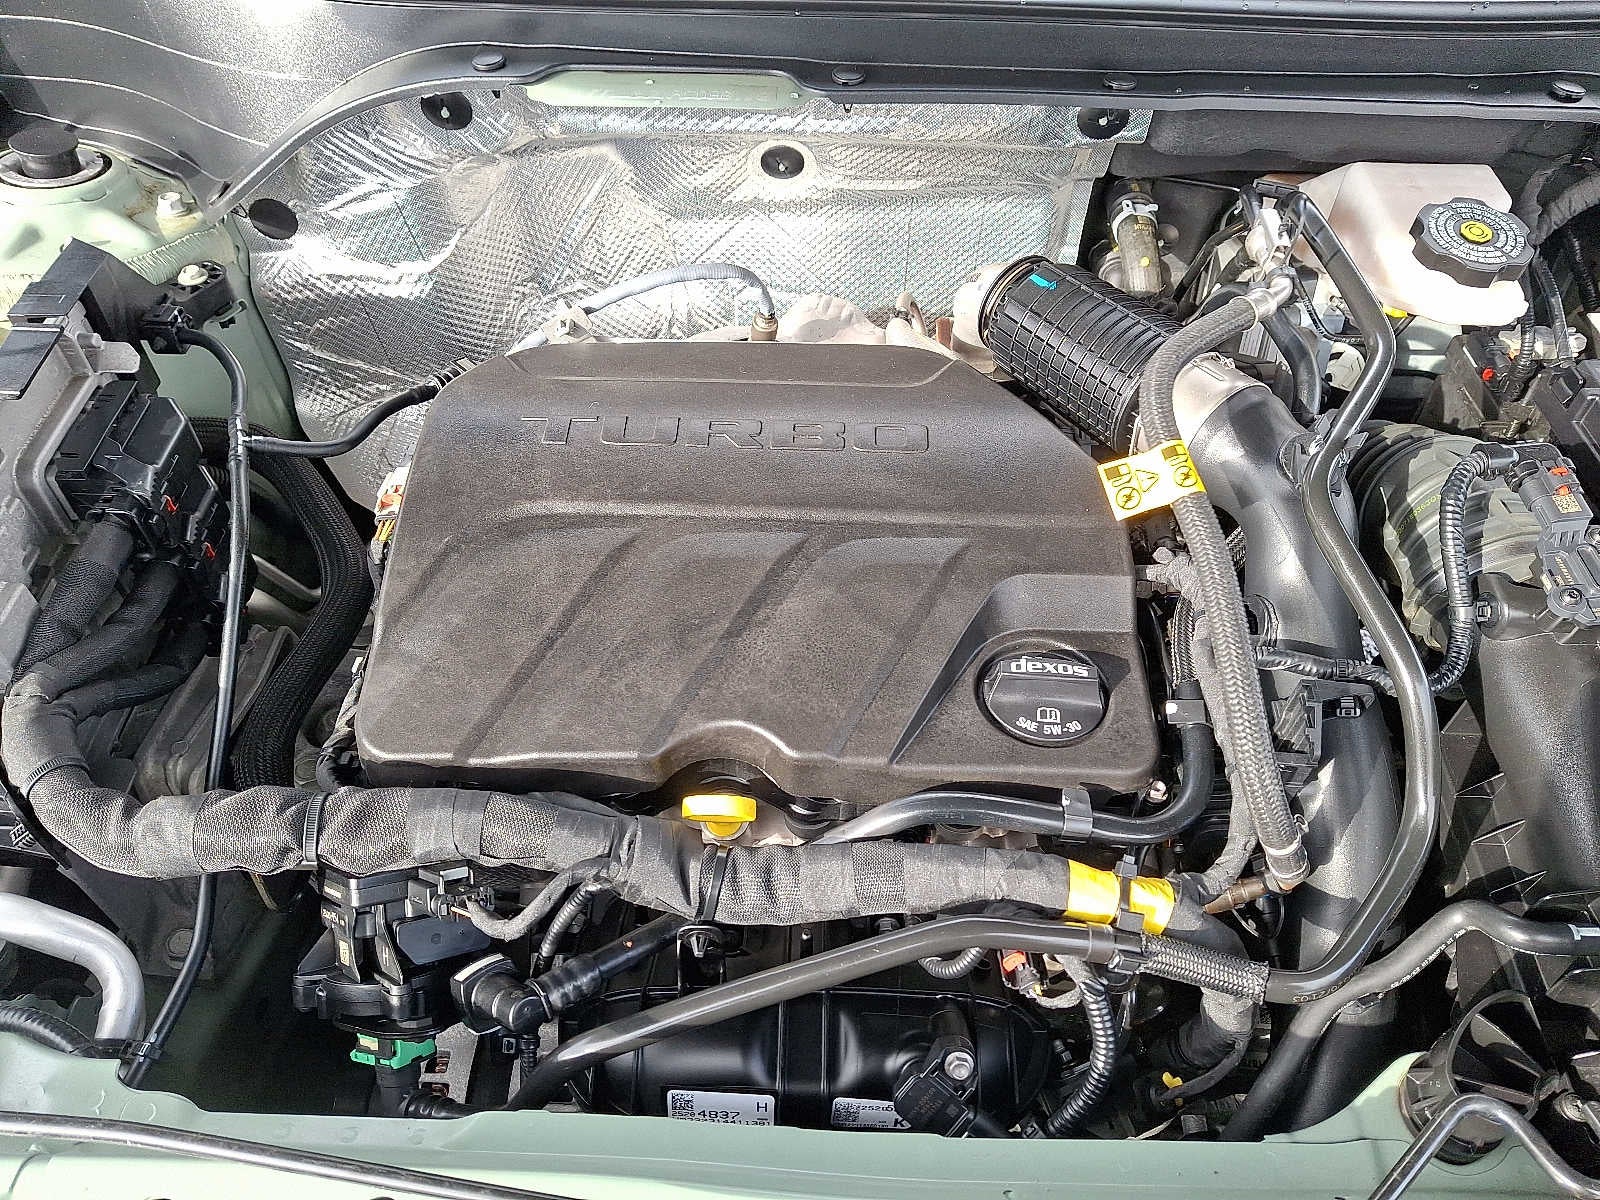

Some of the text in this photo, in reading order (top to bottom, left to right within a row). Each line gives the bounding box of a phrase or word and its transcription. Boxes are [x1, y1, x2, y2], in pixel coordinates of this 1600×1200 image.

[521, 415, 930, 454] TURBO
[1010, 657, 1089, 677] dexos
[1015, 716, 1082, 735] SAE 5W-30
[756, 1101, 768, 1113] H
